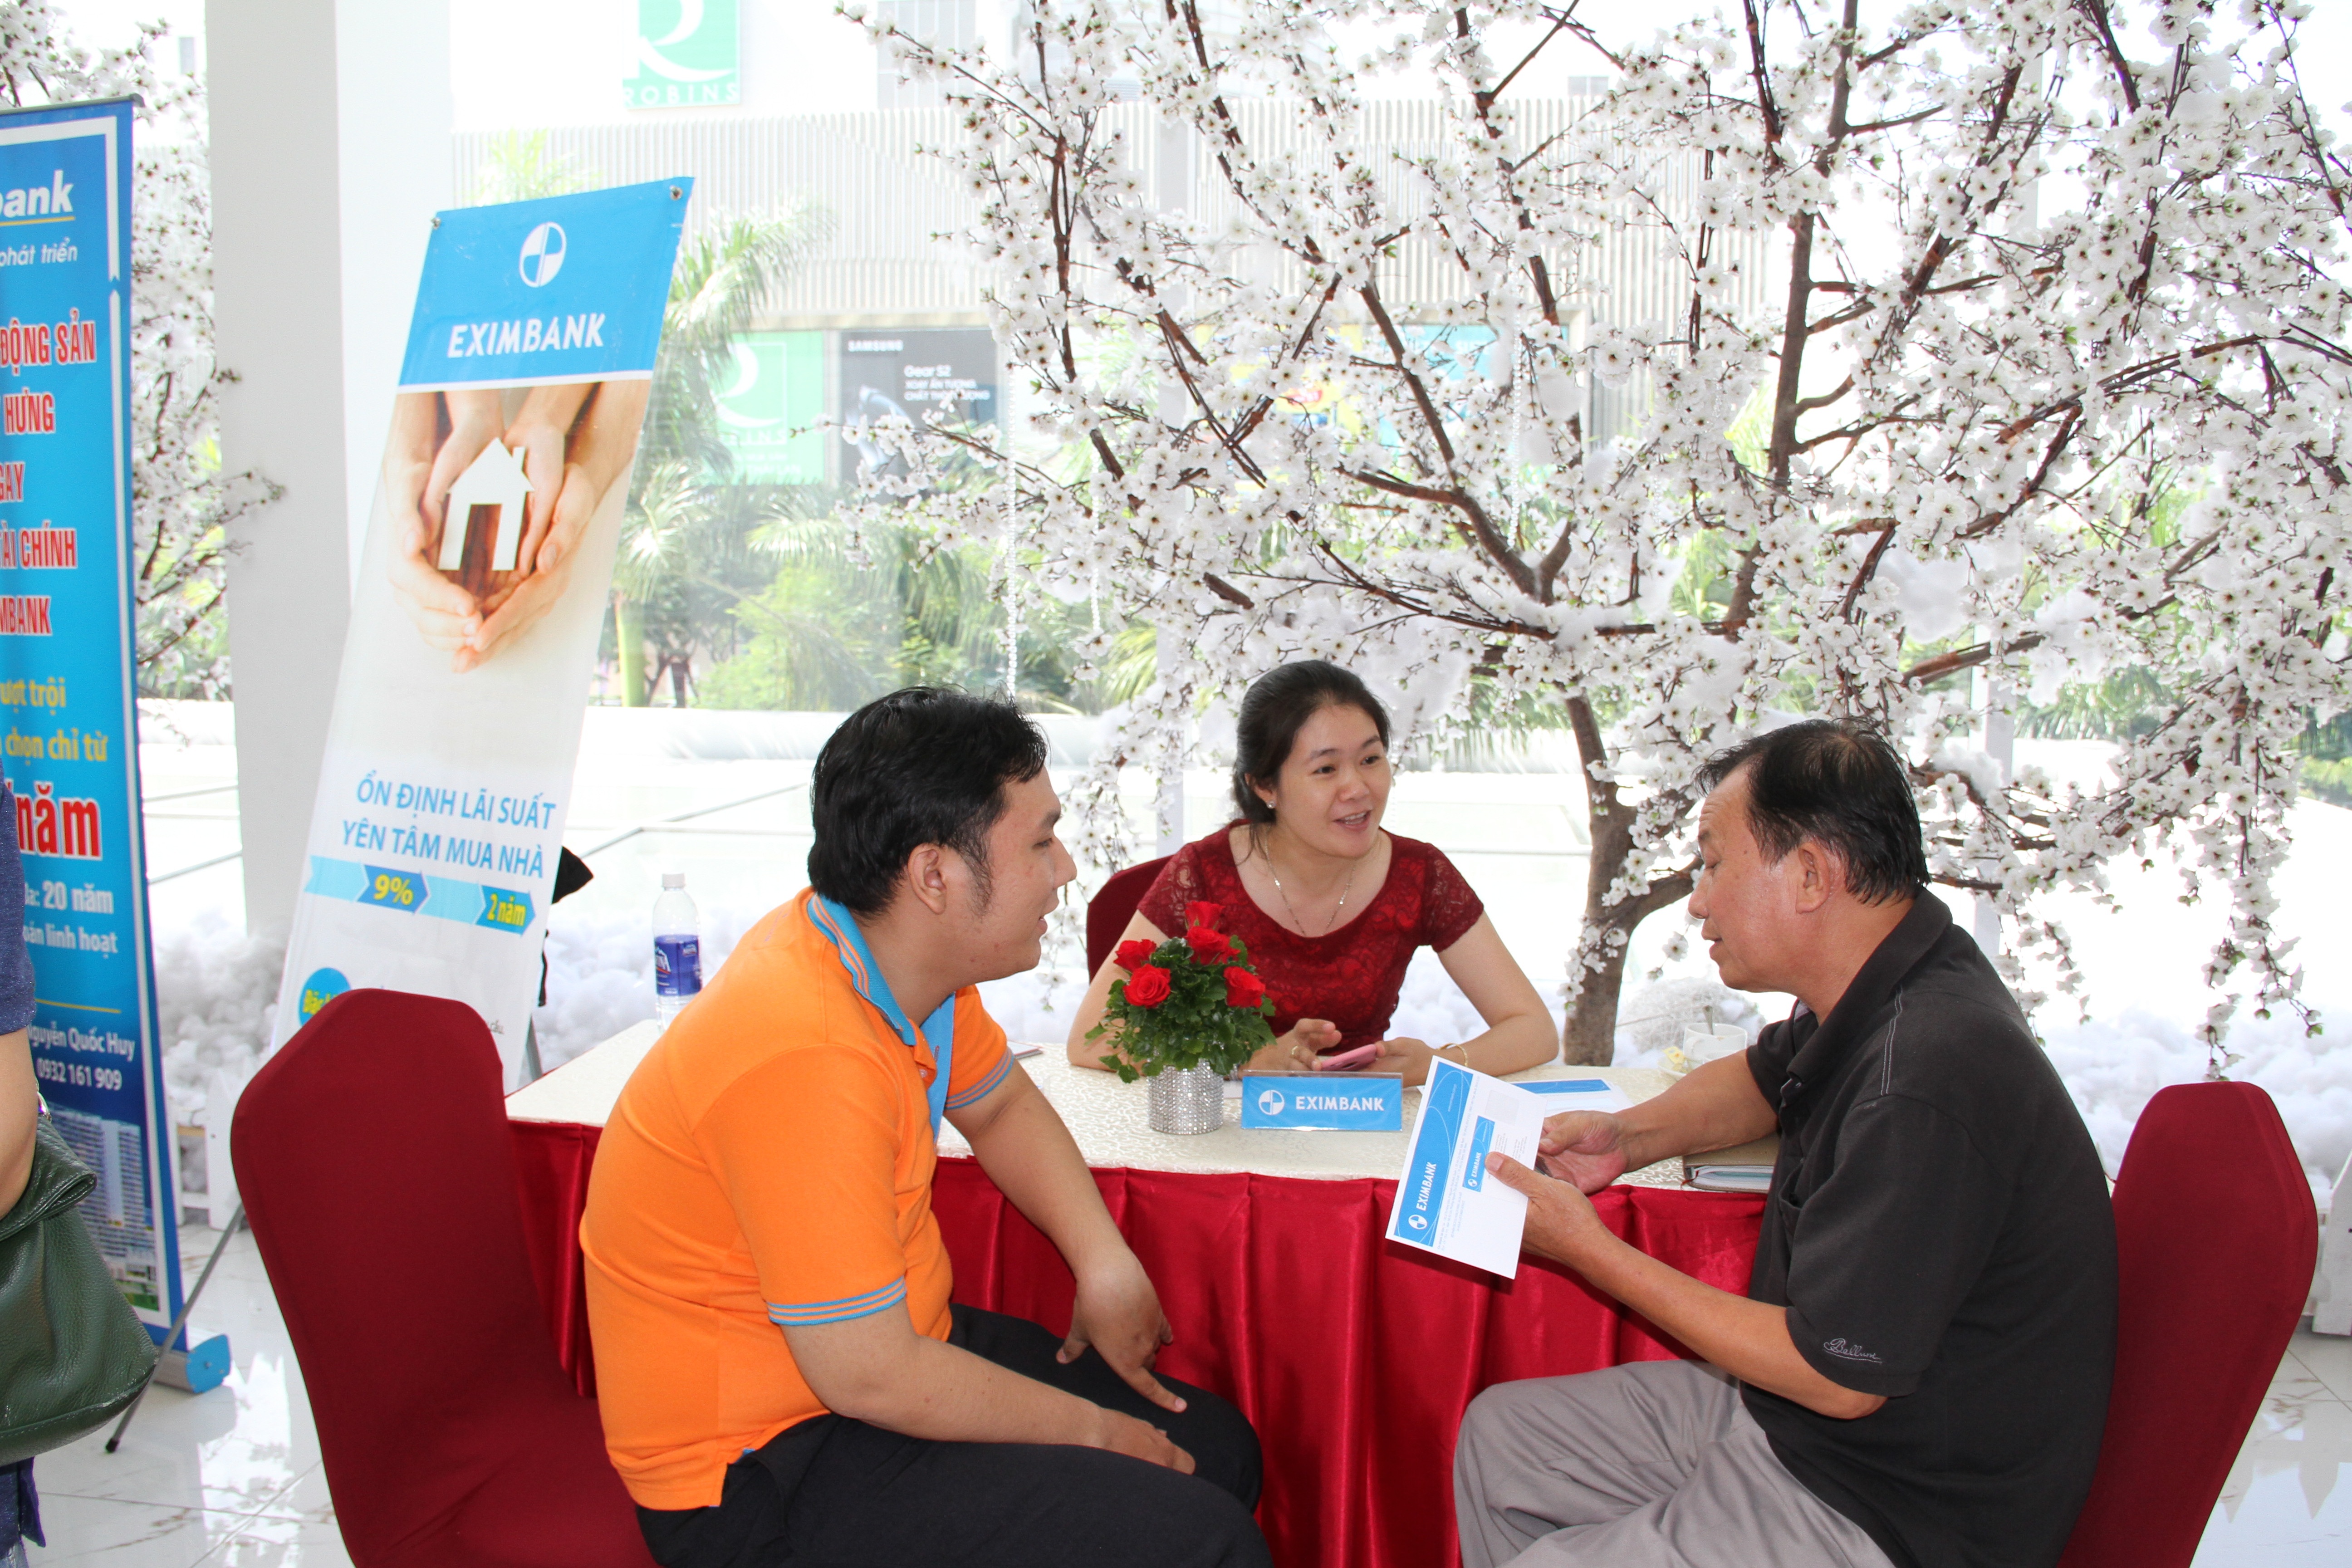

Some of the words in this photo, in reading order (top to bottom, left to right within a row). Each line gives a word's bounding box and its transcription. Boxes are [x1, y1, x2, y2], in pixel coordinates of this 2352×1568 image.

[0, 169, 74, 218] ank
[41, 236, 78, 264] triển
[55, 308, 96, 365] SẢN
[447, 313, 606, 358] EXIMBANK
[848, 340, 903, 352] SAMSUNG
[904, 365, 935, 377] Gear
[936, 365, 951, 377] S2
[4, 387, 55, 435] HƯNG
[20, 520, 77, 569] CHÍNH
[29, 677, 66, 716] trội
[5, 726, 44, 765] chọn
[48, 728, 79, 760] chỉ
[83, 730, 108, 762] từ
[357, 769, 392, 806] ỔN
[396, 783, 456, 818] ĐỊNH
[461, 788, 495, 822] LÃI
[497, 792, 556, 829] SUẤT
[343, 818, 387, 851] YÊN
[392, 826, 441, 861] TÂM
[445, 837, 492, 870] MUA
[498, 844, 543, 878] NHÀ
[42, 880, 67, 911] 20
[71, 882, 114, 914] năm
[373, 874, 413, 906] 9%
[487, 893, 497, 921] 2
[497, 895, 526, 926] năm
[78, 926, 118, 959] hoạt
[68, 1026, 106, 1053] Quốc
[106, 1031, 136, 1062] Huy
[36, 1057, 67, 1083] 0932
[68, 1063, 92, 1087] 161
[93, 1067, 123, 1091] 909
[1295, 1096, 1384, 1111] EXIMBANK
[1471, 1152, 1481, 1178] EXIMBANK
[1416, 1161, 1436, 1211] EXIMBANK
